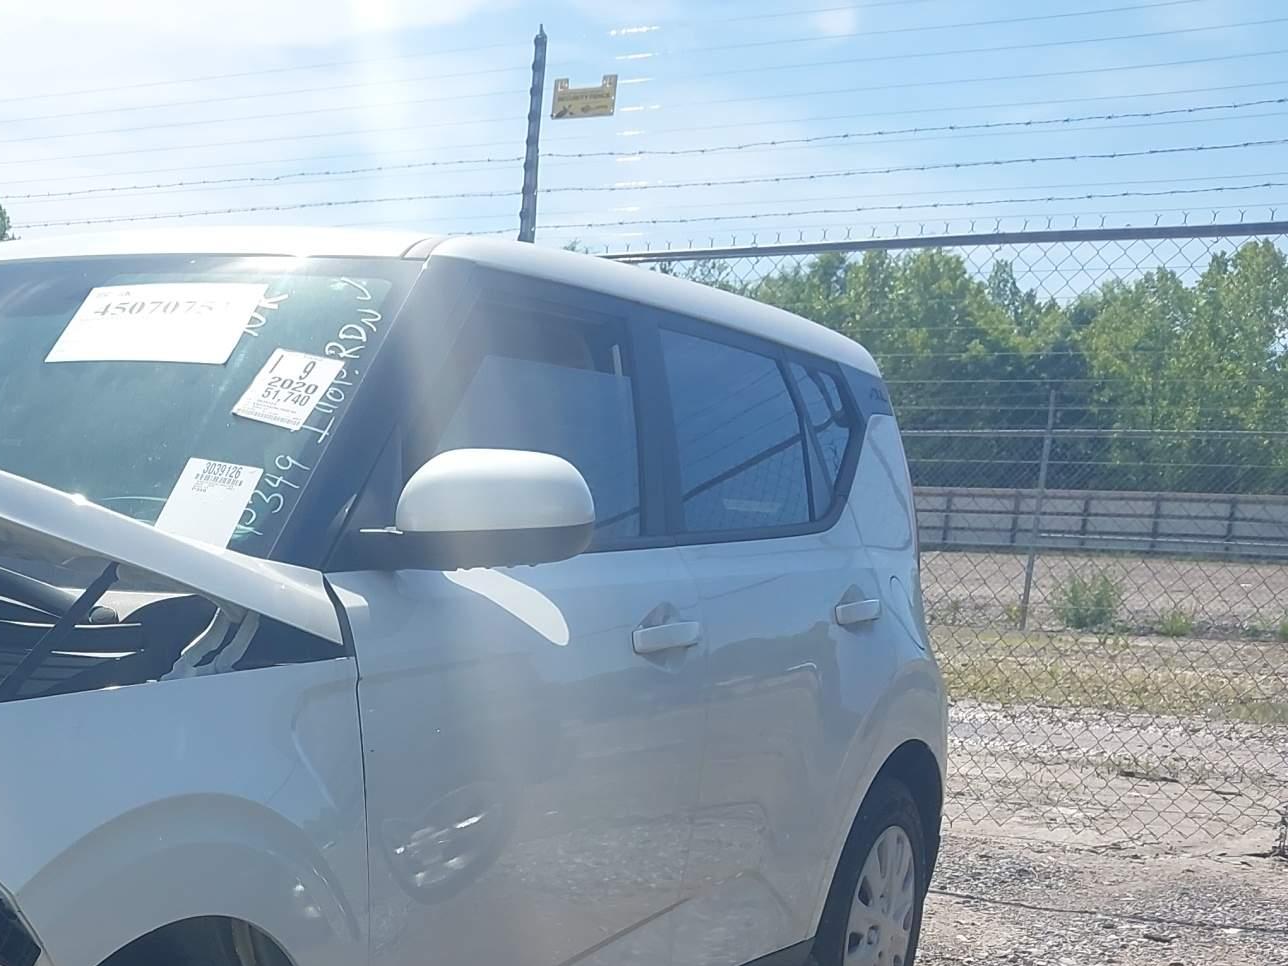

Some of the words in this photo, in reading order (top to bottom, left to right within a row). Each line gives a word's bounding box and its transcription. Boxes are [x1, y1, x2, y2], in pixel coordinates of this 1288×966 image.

[92, 300, 232, 317] 4507075
[299, 360, 317, 380] 9
[267, 376, 319, 395] 2020
[261, 386, 311, 407] 51,740
[202, 461, 244, 480] 3039126
